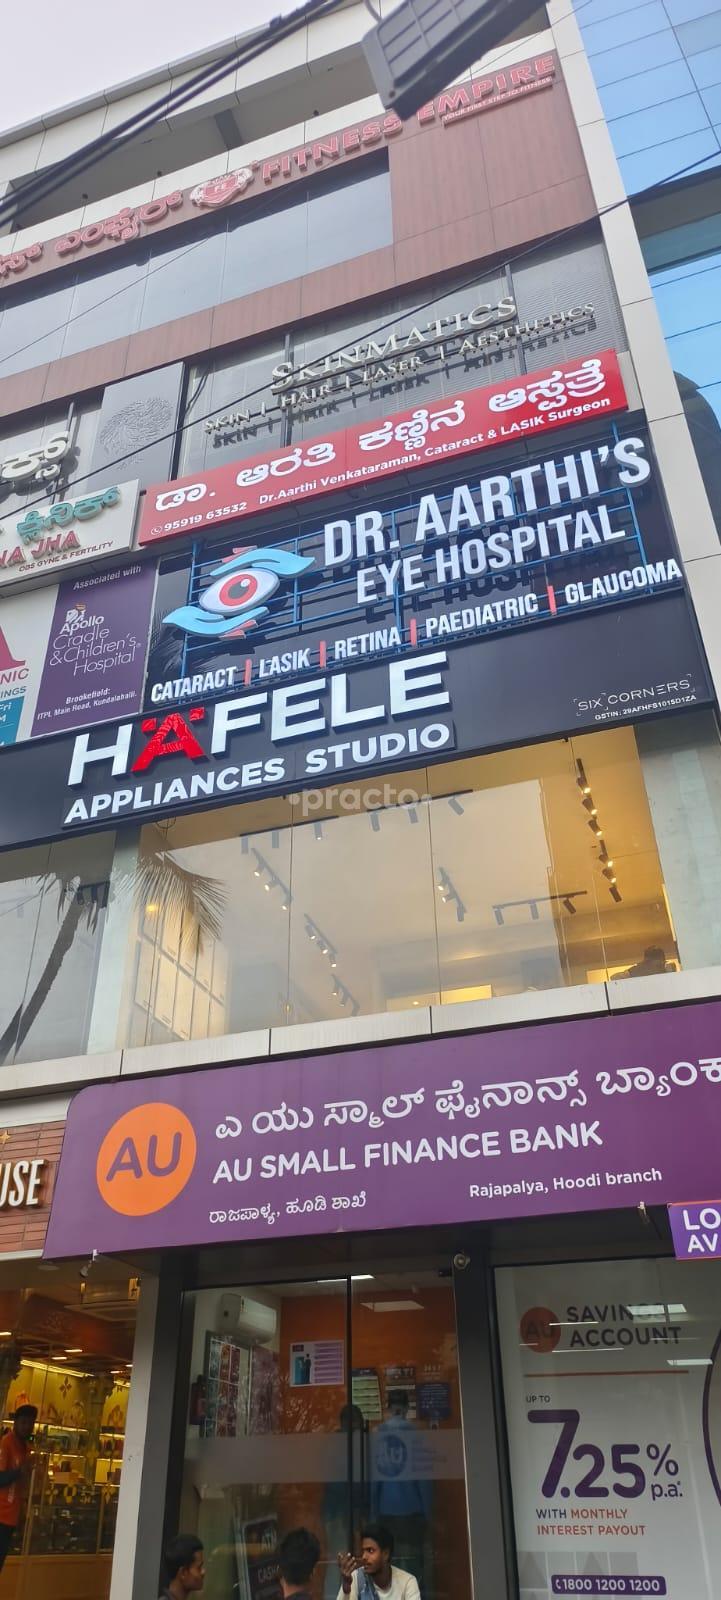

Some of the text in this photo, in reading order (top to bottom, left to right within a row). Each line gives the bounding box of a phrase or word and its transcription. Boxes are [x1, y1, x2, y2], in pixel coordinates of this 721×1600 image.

[262, 55, 556, 183] FITNESS EMPIRE
[270, 296, 517, 394] SKINMATICS
[205, 303, 595, 433] SKIN HAIR LASER AESTHETICS
[164, 514, 203, 532] 95919
[205, 502, 248, 520] 63532
[320, 452, 421, 487] Venkataraman,
[425, 432, 484, 457] Cataract
[487, 429, 497, 440] &
[500, 415, 545, 436] LASIK
[548, 398, 611, 422] Surgeon
[324, 437, 651, 567] DR. AARTHI'S
[31, 530, 80, 559] JHA
[70, 541, 113, 558] FERTILITY
[356, 506, 626, 604] EYE HOSPITAL
[73, 564, 142, 591] Associated with
[53, 624, 110, 650] Cradle
[60, 615, 105, 636] Apollo
[151, 558, 683, 702] CATARACT LASIK RETINA PAEDIATRIC GLAUCOMA
[73, 645, 136, 676] Hospital
[578, 679, 691, 711] SIX CORNERS
[54, 706, 71, 717] Main
[63, 722, 451, 824] APPLIANCES STUDIO
[215, 1115, 243, 1139] ಎ
[252, 1101, 314, 1135] ಯು
[323, 1087, 426, 1129] ಸ್ಮಾಲ್
[106, 1131, 182, 1182] AU
[212, 1120, 603, 1184] AU SMALL FINANCE BANK
[469, 1168, 662, 1199] Rajapalya, Hoodi branch
[286, 1195, 327, 1214] ಹೂಡಿ
[688, 1233, 718, 1253] AV
[569, 1326, 682, 1347] ACCOUNT
[526, 1395, 551, 1403] UP TO
[536, 1508, 628, 1519] WITH MONTHLY
[537, 1525, 646, 1536] INTEREST PAYOUT
[562, 1578, 661, 1592] 1800 1200 1200
